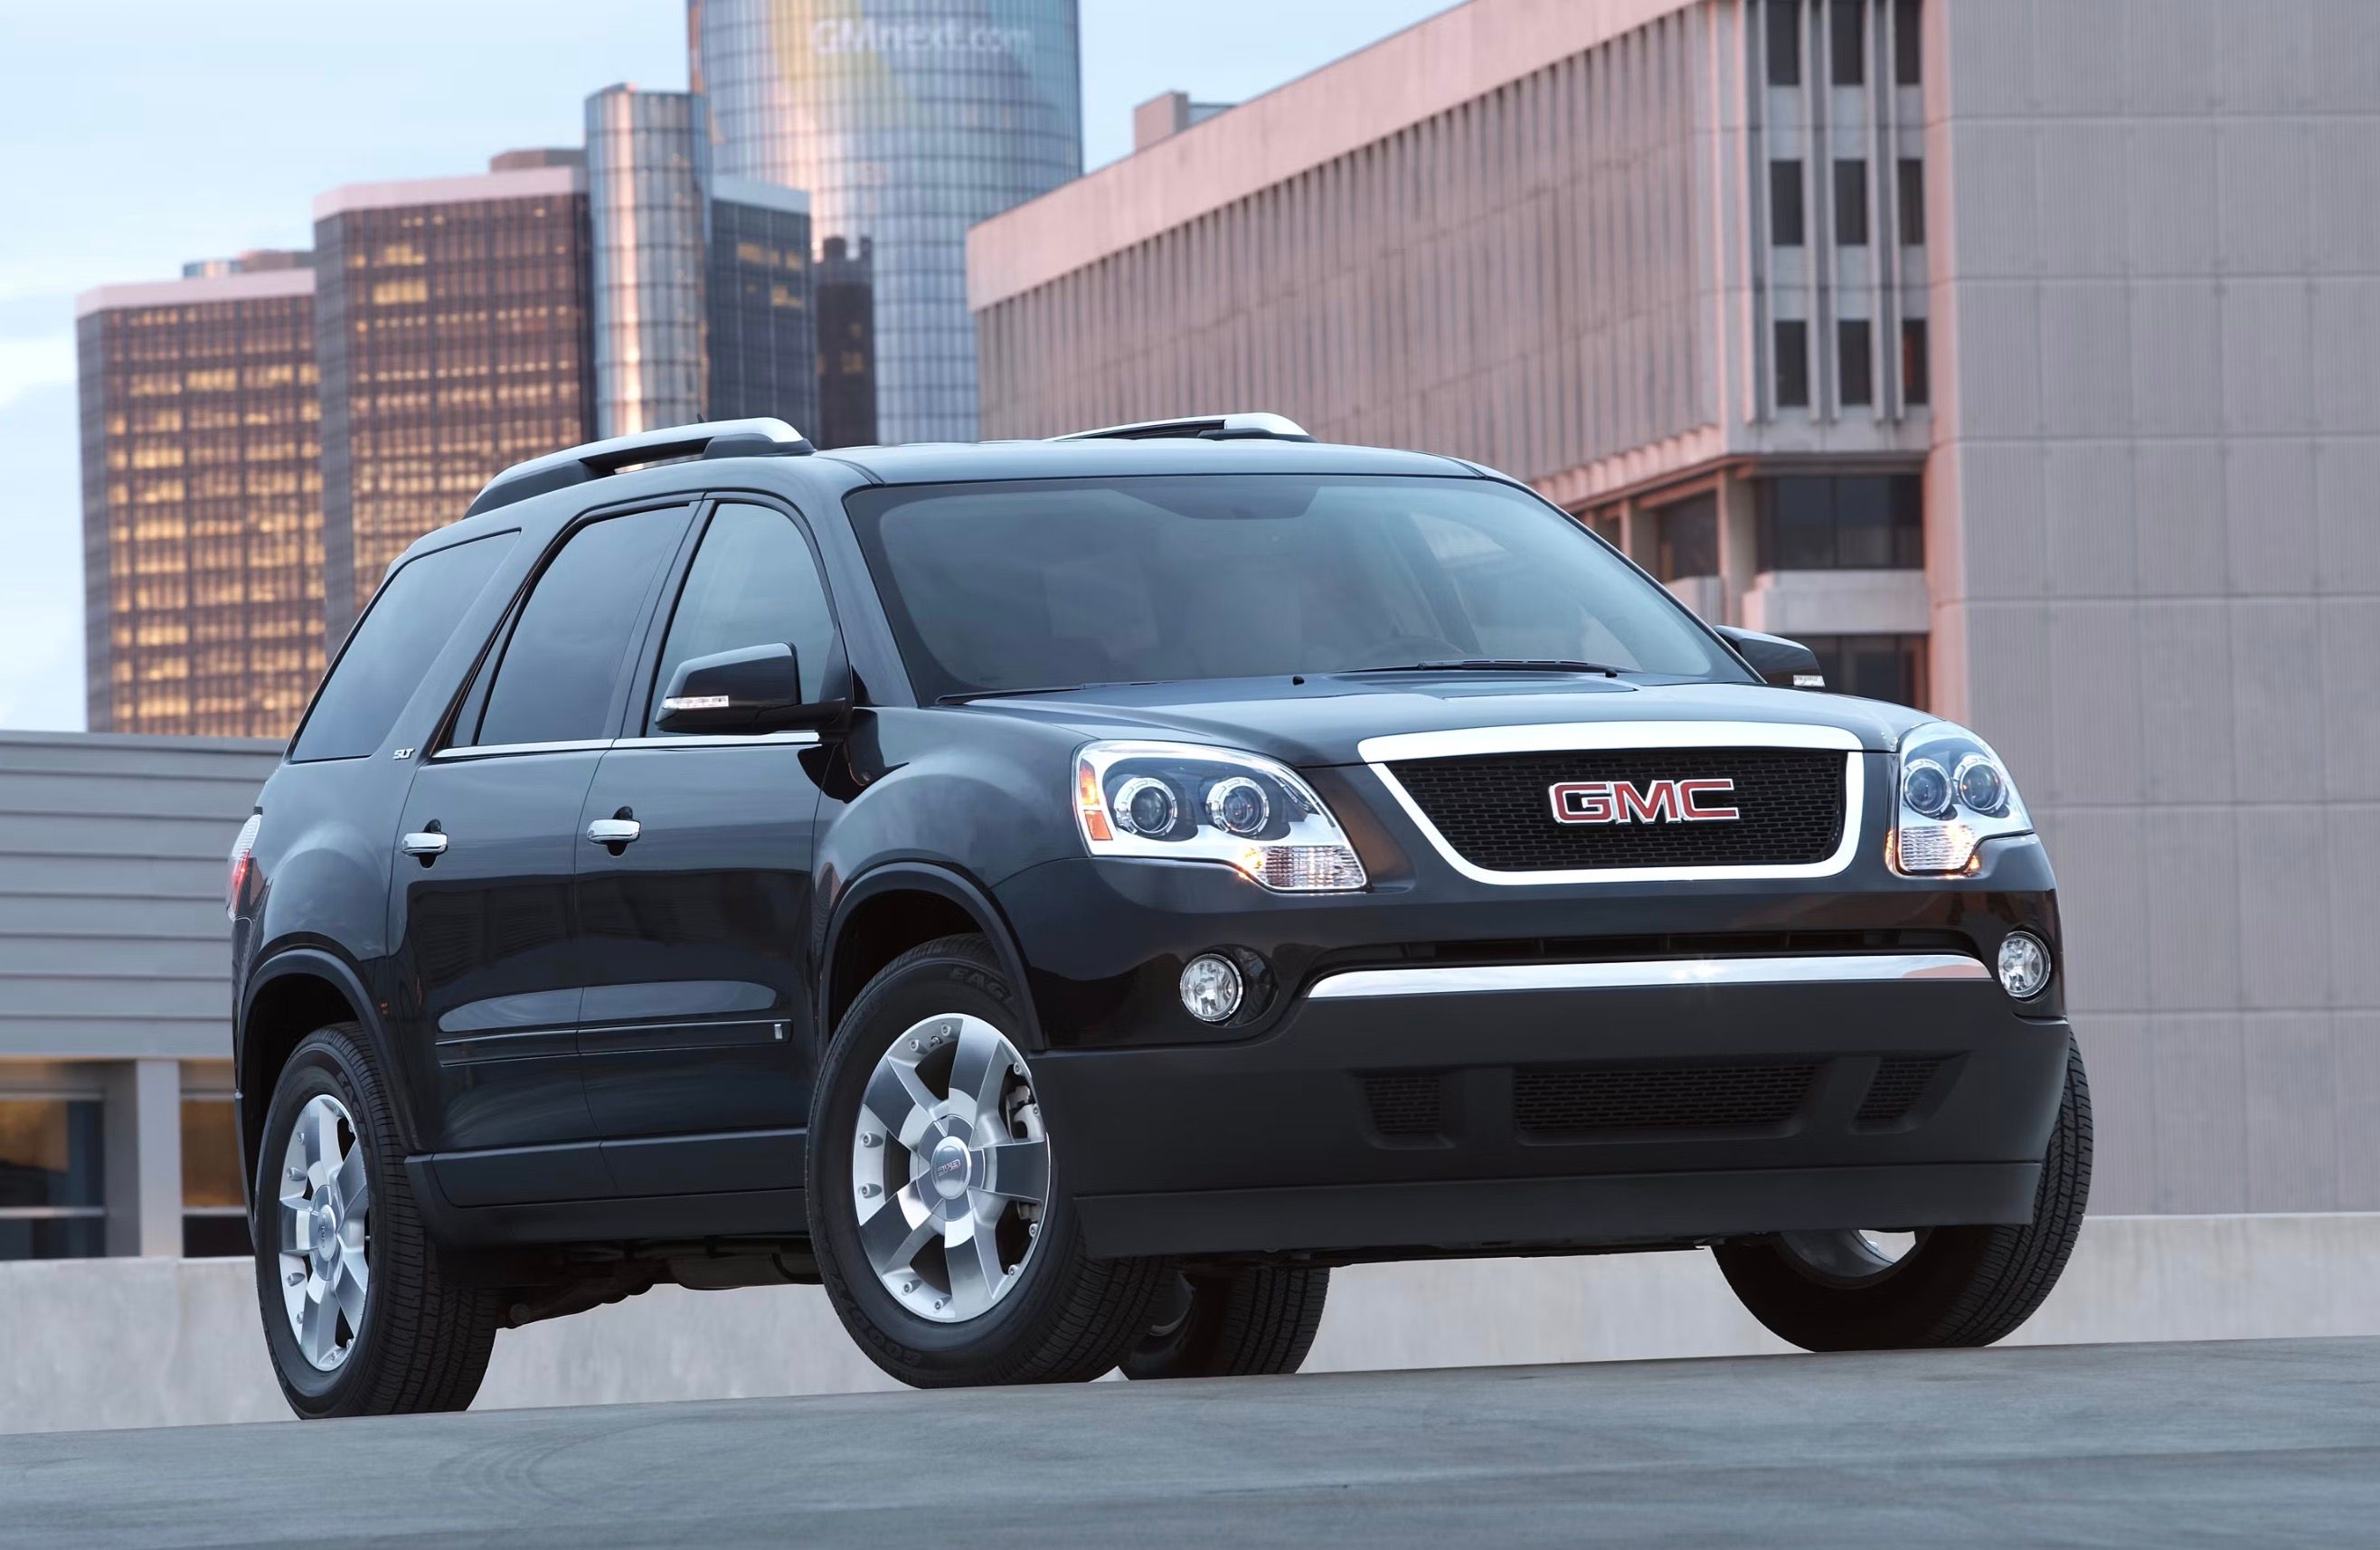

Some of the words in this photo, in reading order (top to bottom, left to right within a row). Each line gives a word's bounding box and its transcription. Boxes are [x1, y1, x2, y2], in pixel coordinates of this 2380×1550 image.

[393, 748, 415, 760] SLT
[1549, 778, 1741, 825] GMC
[938, 1159, 960, 1177] GMC
